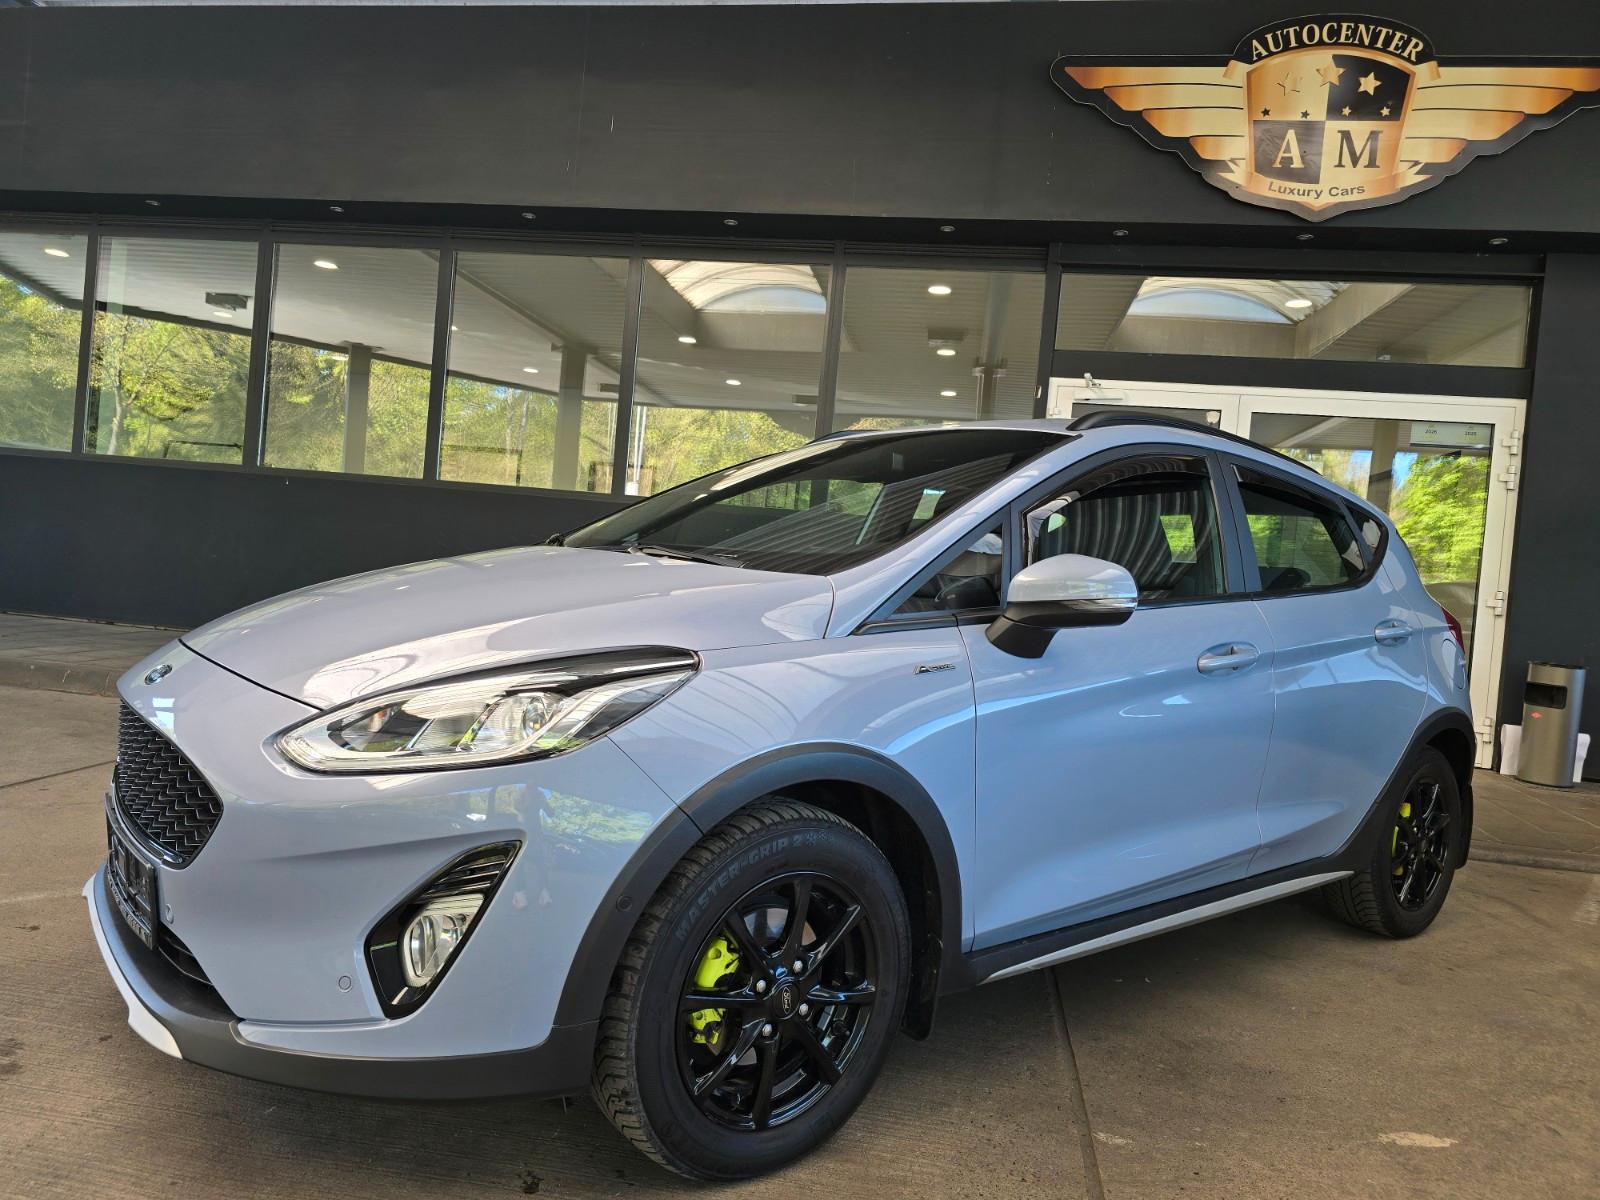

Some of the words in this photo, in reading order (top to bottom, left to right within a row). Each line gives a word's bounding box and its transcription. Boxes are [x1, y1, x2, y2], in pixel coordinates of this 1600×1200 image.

[1252, 22, 1424, 61] AUTOCENTER
[1272, 129, 1304, 168] A
[1334, 130, 1383, 169] M
[1268, 181, 1323, 199] Luxury
[1328, 185, 1365, 197] Cars
